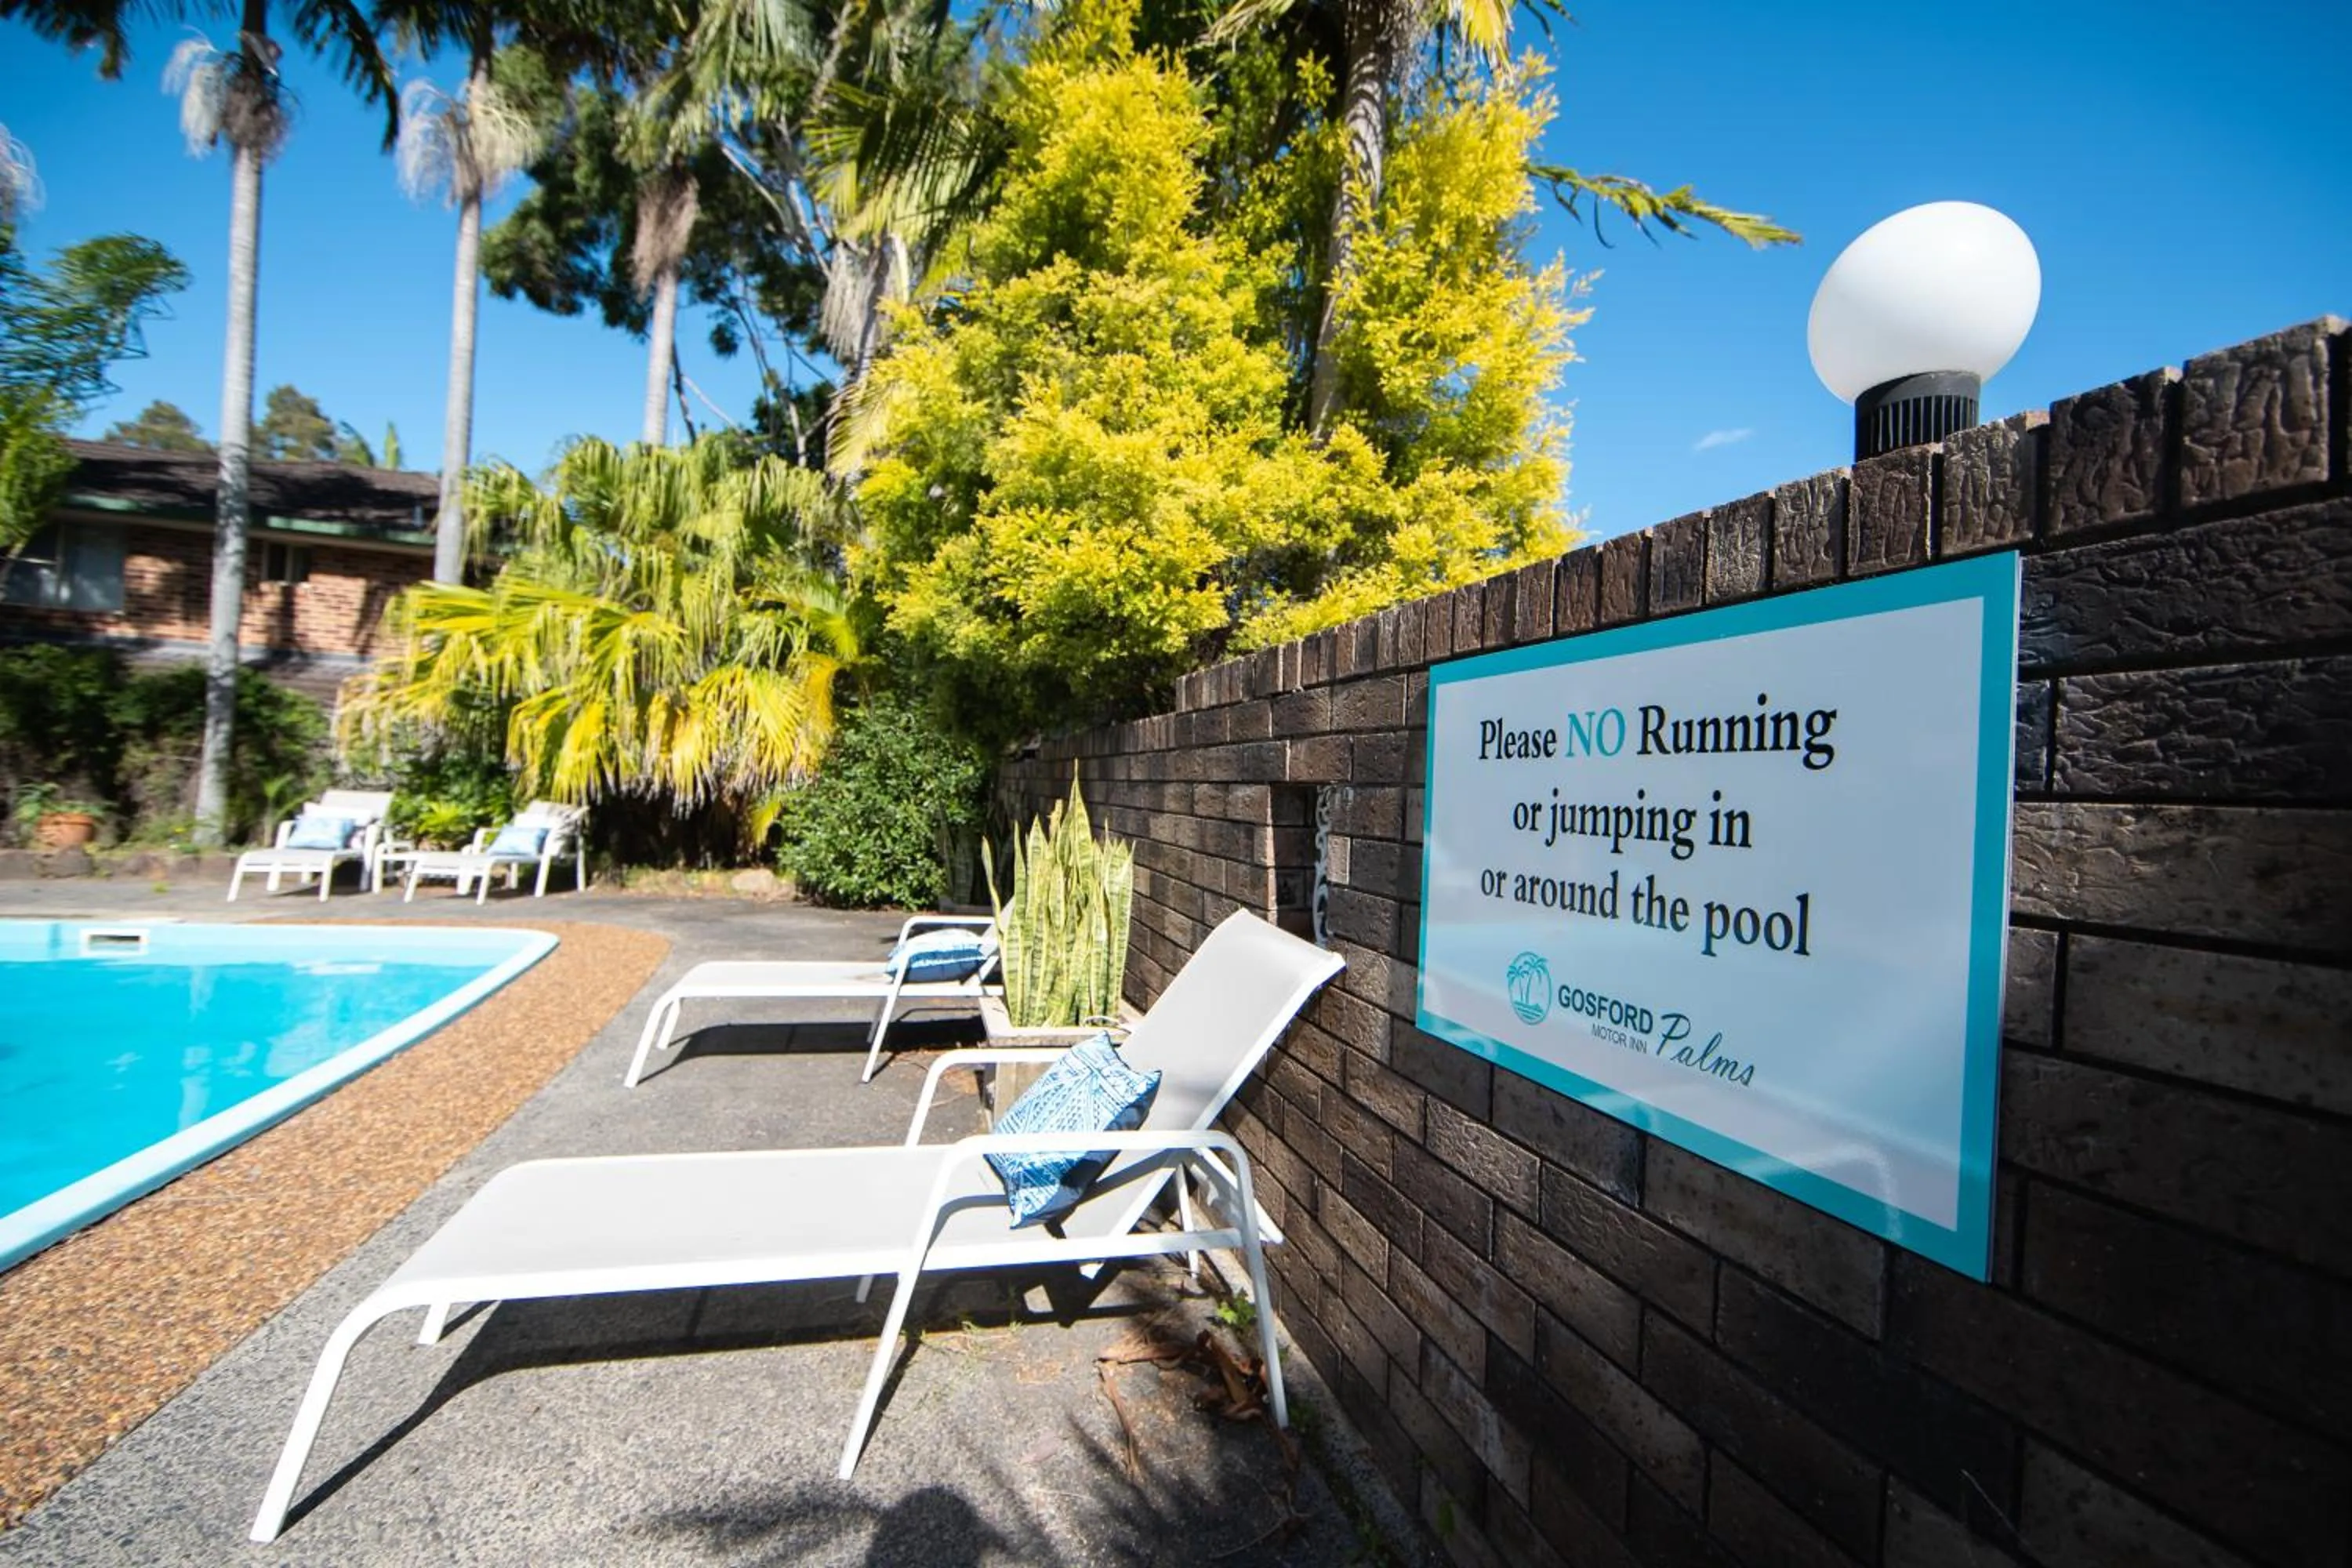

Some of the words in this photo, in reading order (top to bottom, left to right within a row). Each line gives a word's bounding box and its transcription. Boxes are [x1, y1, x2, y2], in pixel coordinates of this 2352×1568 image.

[1479, 717, 1556, 760] Please
[1565, 708, 1626, 758] NO
[1637, 693, 1838, 770] Running
[1513, 800, 1542, 832] or
[1544, 788, 1697, 860] jumping
[1708, 789, 1752, 848] in
[1481, 868, 1508, 899] or
[1514, 870, 1620, 920] around
[1632, 874, 1690, 932] the
[1701, 892, 1810, 956] pool
[1558, 985, 1654, 1035] GOSFORD
[1656, 1013, 1755, 1087] Palms
[1592, 1023, 1628, 1049] MOTOR
[1629, 1037, 1647, 1054] INN
